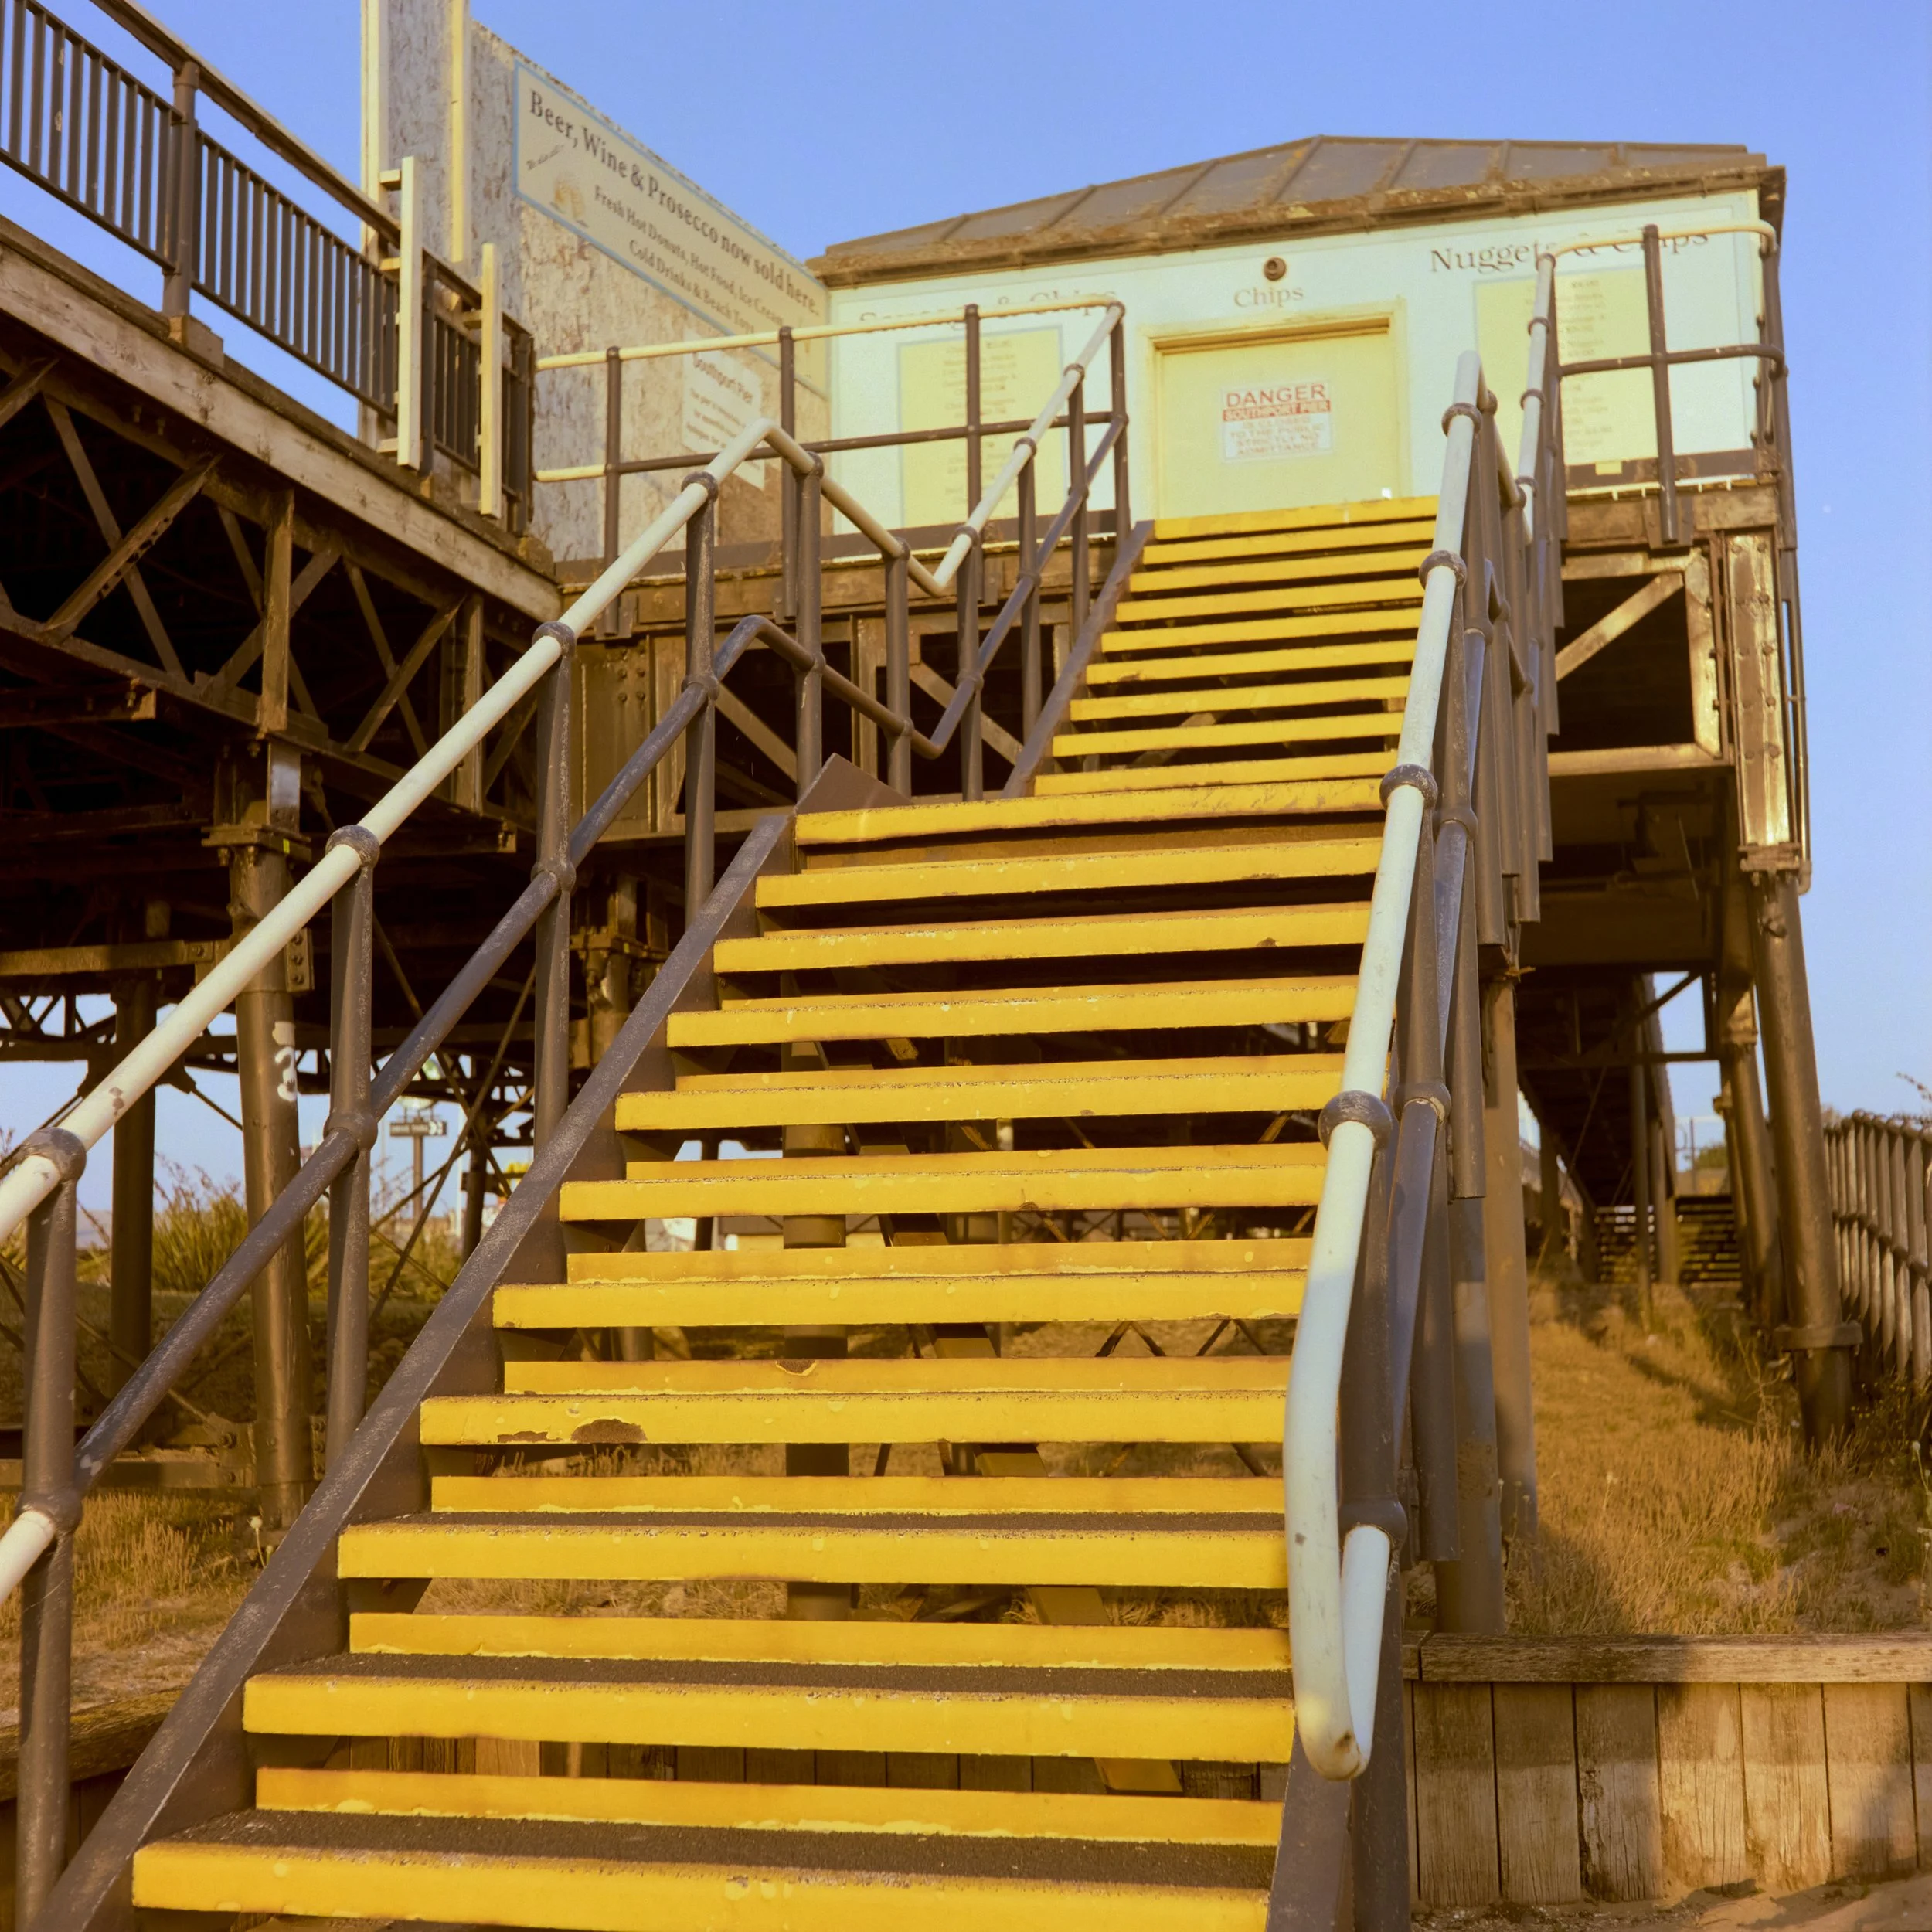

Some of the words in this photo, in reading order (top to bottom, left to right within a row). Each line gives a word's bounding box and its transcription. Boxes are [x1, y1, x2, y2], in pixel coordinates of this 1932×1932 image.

[530, 90, 578, 148] Beer,
[582, 125, 627, 178] Wine
[631, 163, 644, 192] &
[648, 174, 719, 244] Prosecco
[720, 234, 753, 267] now
[754, 258, 784, 291] sold
[786, 273, 819, 316] here.
[594, 185, 624, 218] Fresh
[627, 206, 647, 234] Hot
[648, 222, 689, 265] Donuts,
[690, 252, 709, 277] Hot
[739, 285, 753, 307] Ice
[1431, 240, 1556, 274] Nugget
[629, 239, 655, 267] Cold
[656, 257, 692, 293] Drinks
[693, 281, 702, 299] &
[702, 288, 732, 319] Beach
[1233, 287, 1304, 308] Chips
[1225, 403, 1294, 421] SOUTHPORT
[1226, 383, 1326, 408] DANGER
